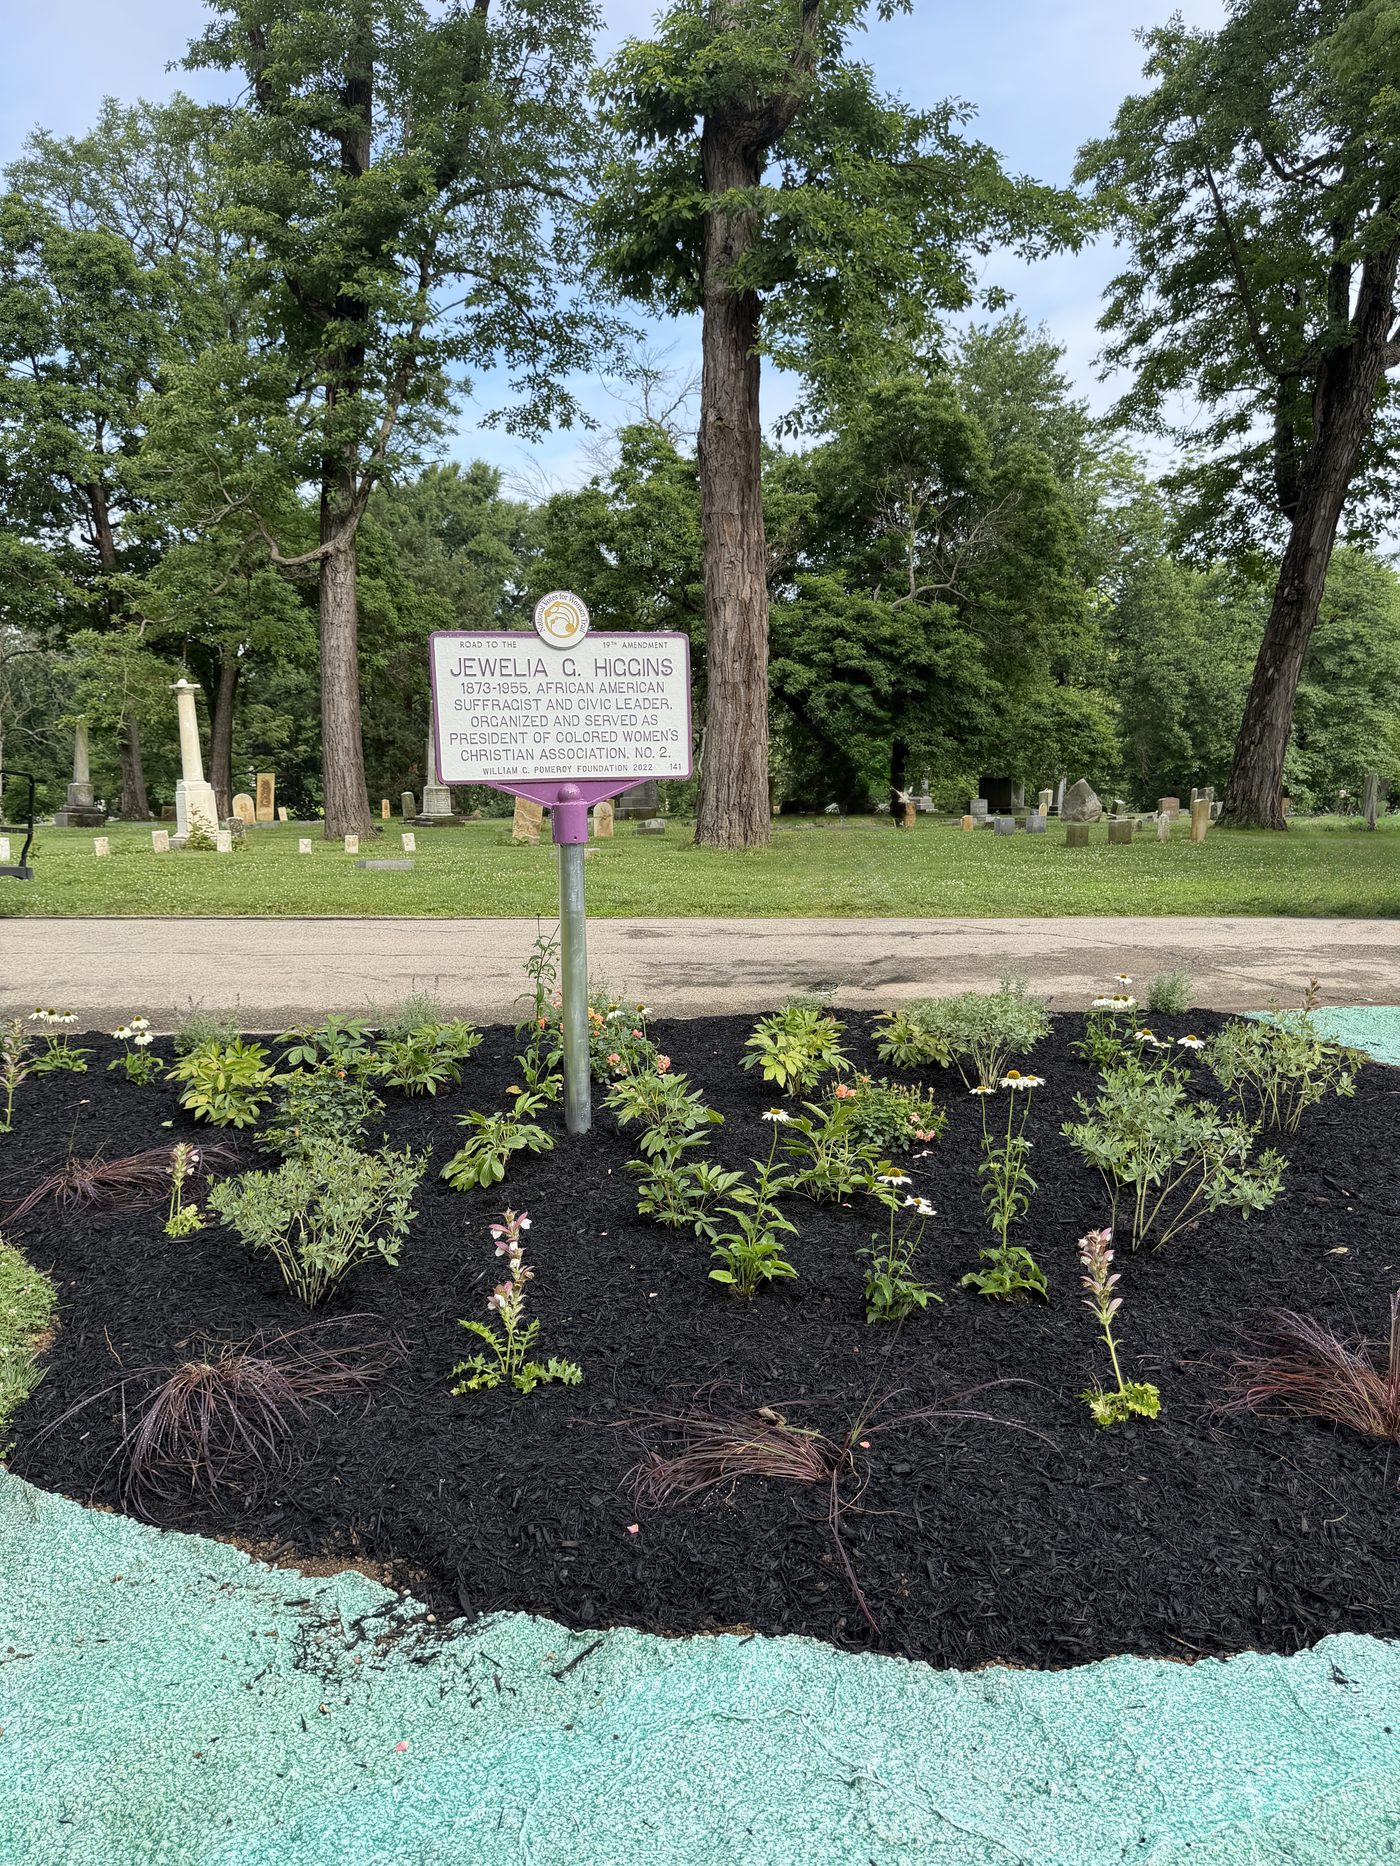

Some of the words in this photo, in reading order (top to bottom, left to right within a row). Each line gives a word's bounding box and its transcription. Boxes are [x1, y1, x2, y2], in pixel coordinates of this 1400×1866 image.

[559, 592, 568, 601] for
[459, 640, 483, 649] ROAD
[486, 640, 499, 649] TO
[502, 640, 517, 649] THE
[621, 641, 669, 649] AMENDMENT
[450, 657, 548, 677] JEWELIA
[562, 657, 581, 677] G.
[594, 657, 674, 677] HIGGINS
[536, 681, 595, 694] AFRICAN
[598, 680, 665, 694] AMERICAN
[453, 698, 542, 711] SUFFRAGIST
[546, 698, 573, 711] AND
[577, 697, 612, 711] CIVIC
[470, 715, 549, 728] ORGANIZED
[553, 715, 580, 727] AND
[584, 714, 638, 727] SERVED
[641, 714, 659, 726] AS
[449, 732, 528, 745] PRESIDENT
[533, 731, 551, 744] OF
[556, 731, 618, 743] COLORED
[622, 728, 679, 742] WOMEN'S
[460, 748, 534, 762] CHRISTIAN
[635, 746, 656, 759] NO.
[659, 746, 671, 758] 2.
[482, 766, 518, 775] WILLIAM
[522, 766, 530, 774] C.
[534, 765, 572, 774] POMEROY
[577, 764, 628, 773] FOUNDATION
[632, 763, 653, 772] 2022
[669, 763, 682, 771] 141
